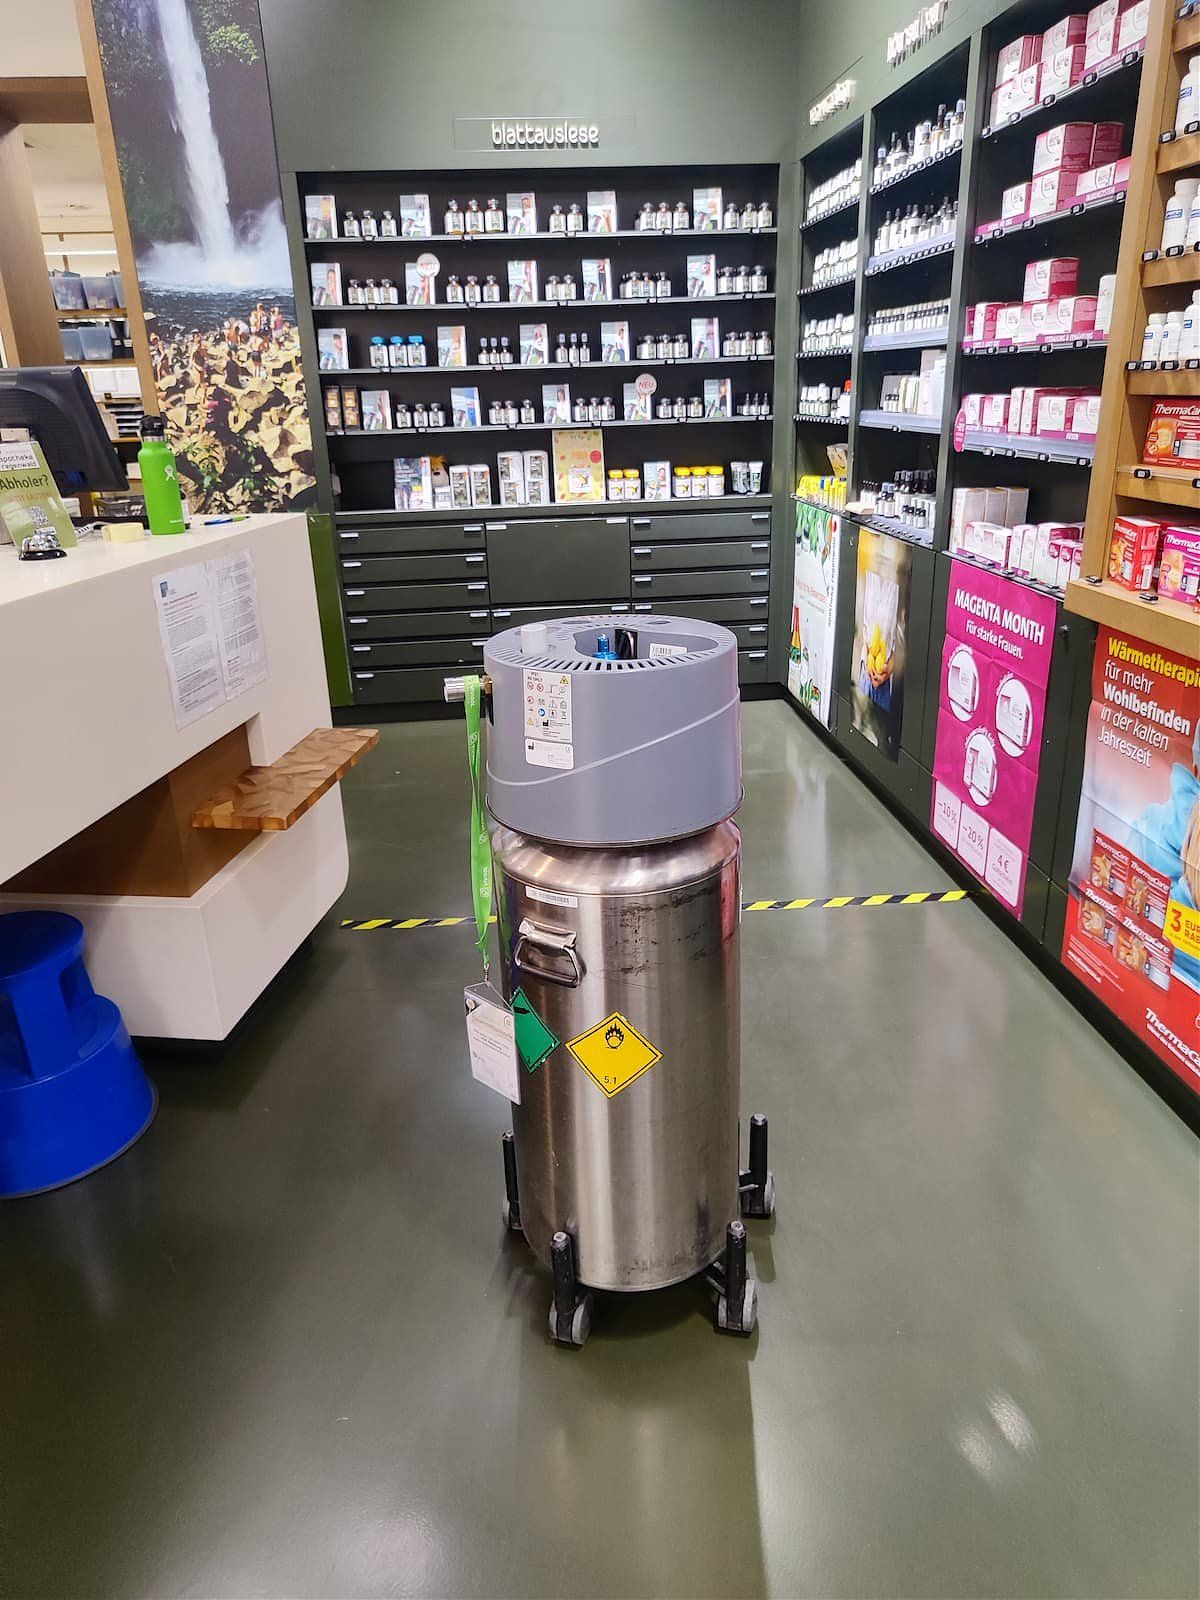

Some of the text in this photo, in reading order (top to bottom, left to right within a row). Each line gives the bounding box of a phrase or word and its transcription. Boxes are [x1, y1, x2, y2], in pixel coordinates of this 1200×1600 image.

[491, 120, 600, 149] blattauslese
[0, 474, 48, 490] Abholer?
[955, 588, 1046, 645] MAGENTA MONTH
[965, 620, 977, 635] Für
[976, 625, 999, 647] starke
[1105, 659, 1155, 695] für mehr
[1103, 681, 1191, 736] Wohlbefinden
[1100, 703, 1169, 752] in der kalten
[1098, 726, 1153, 768] Jahreszeit
[1122, 916, 1171, 954] ThermaCare
[1171, 908, 1182, 933] 3
